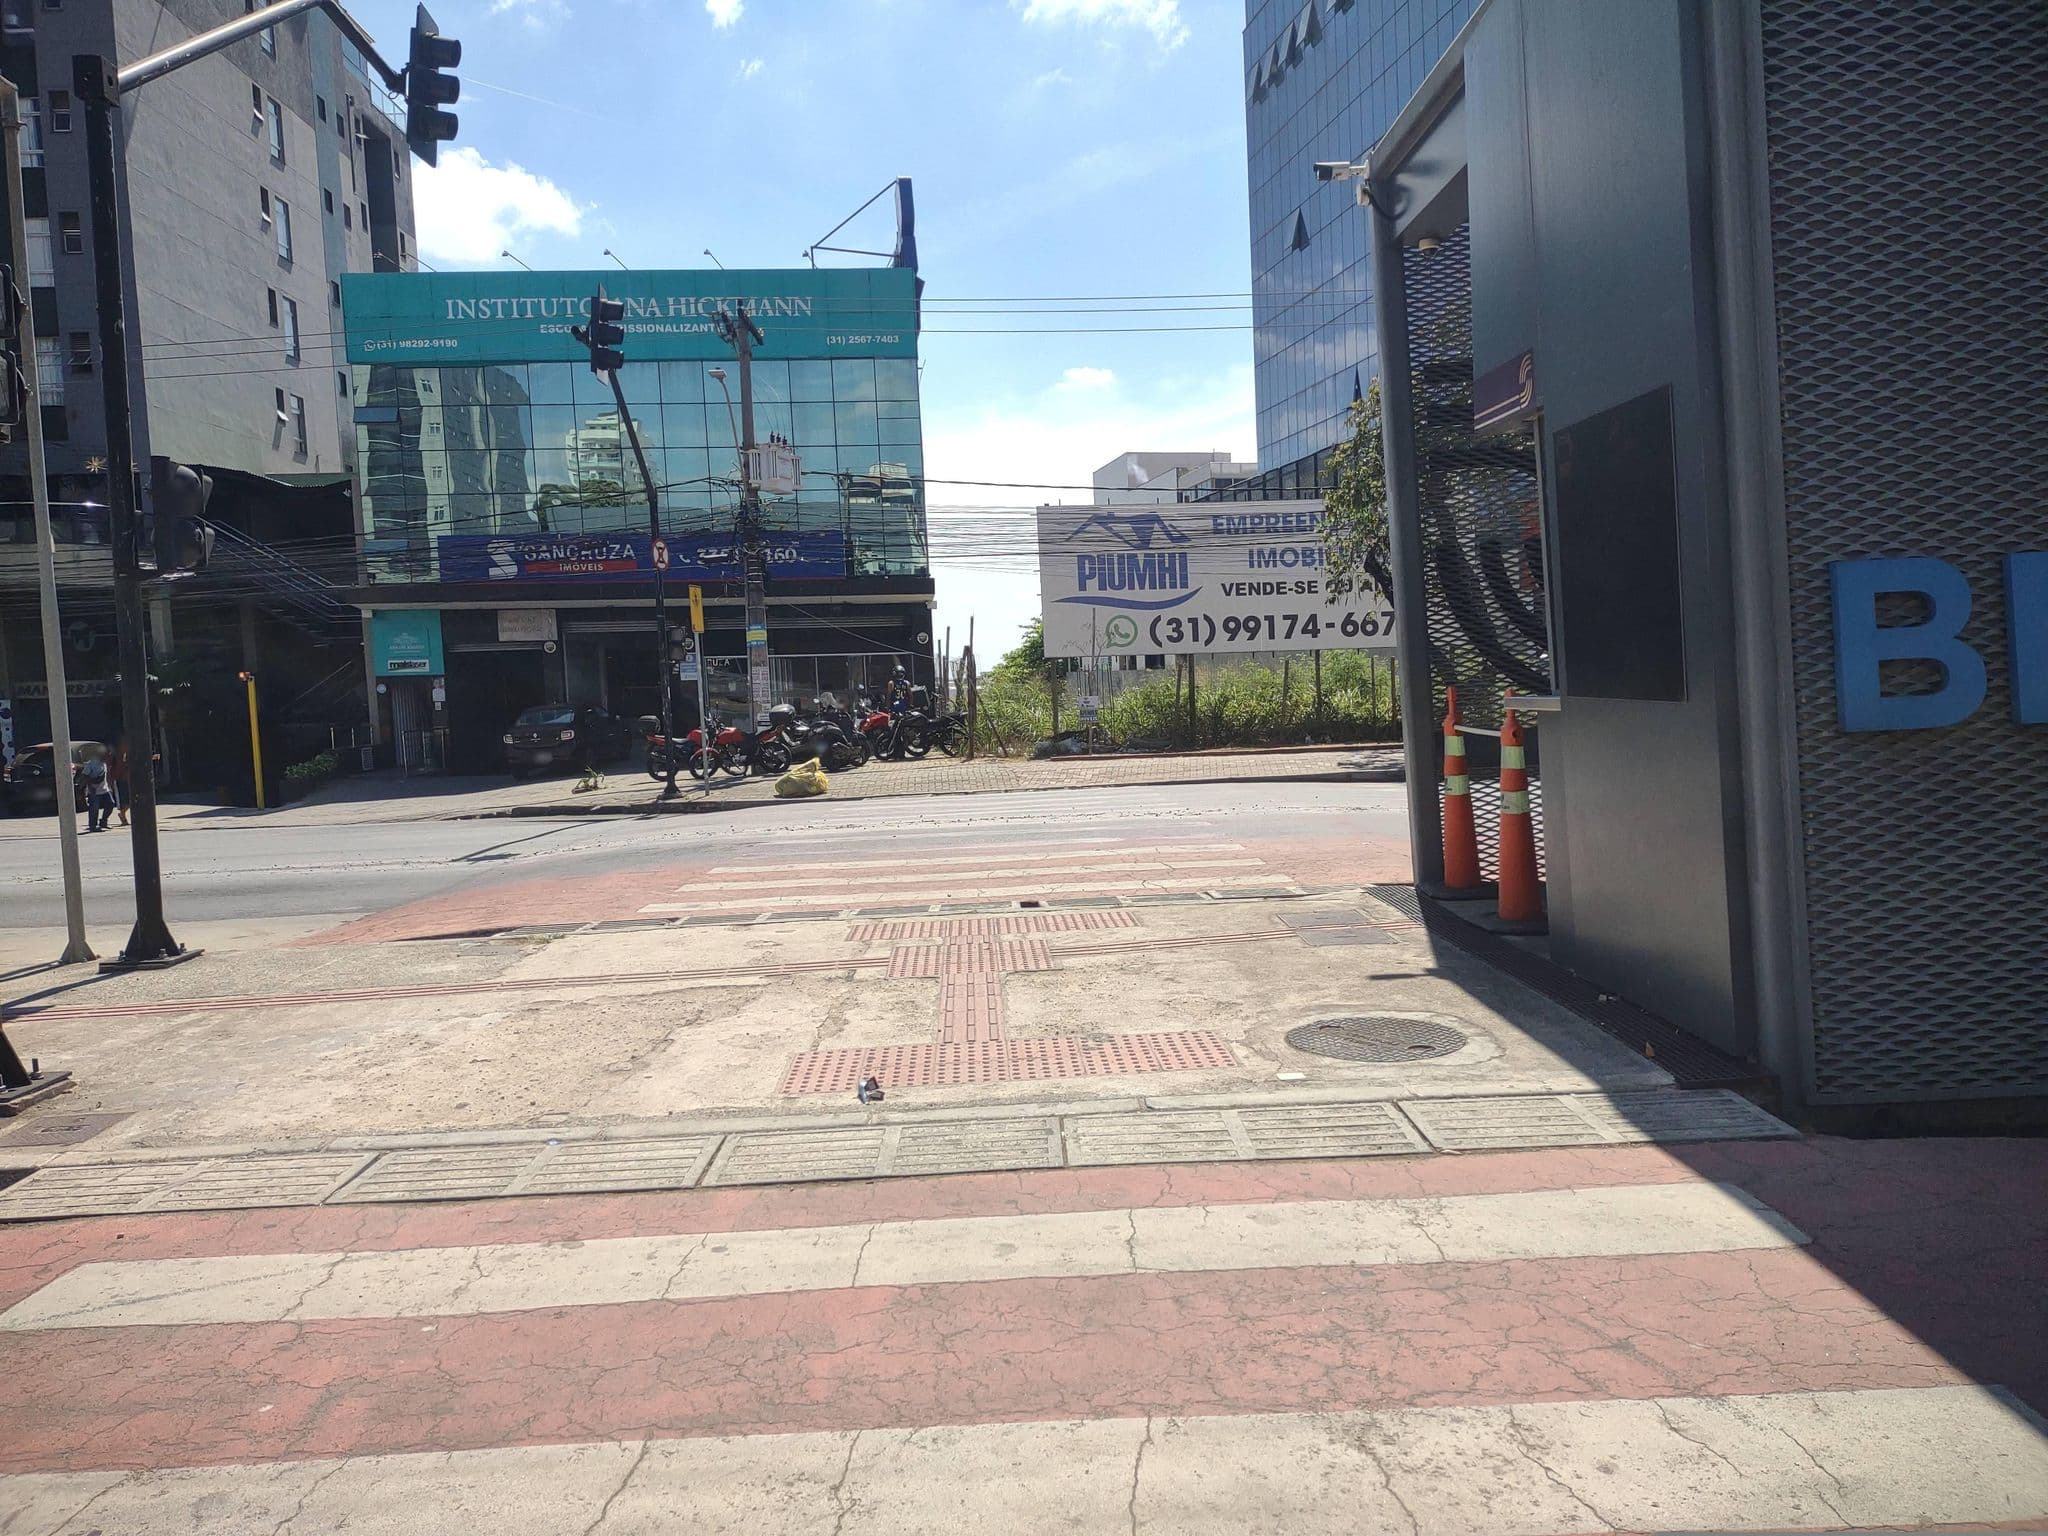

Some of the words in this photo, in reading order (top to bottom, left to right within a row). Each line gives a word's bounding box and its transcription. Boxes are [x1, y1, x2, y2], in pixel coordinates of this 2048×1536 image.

[614, 296, 666, 318] NA
[667, 296, 813, 318] HICKMANN
[377, 340, 397, 350] (31)
[399, 339, 458, 349] 98292-9190
[827, 335, 846, 346] (31)
[848, 335, 899, 345] 2567-7403
[559, 562, 604, 572] IMÓVEIS
[1221, 580, 1319, 597] VENDE-SE
